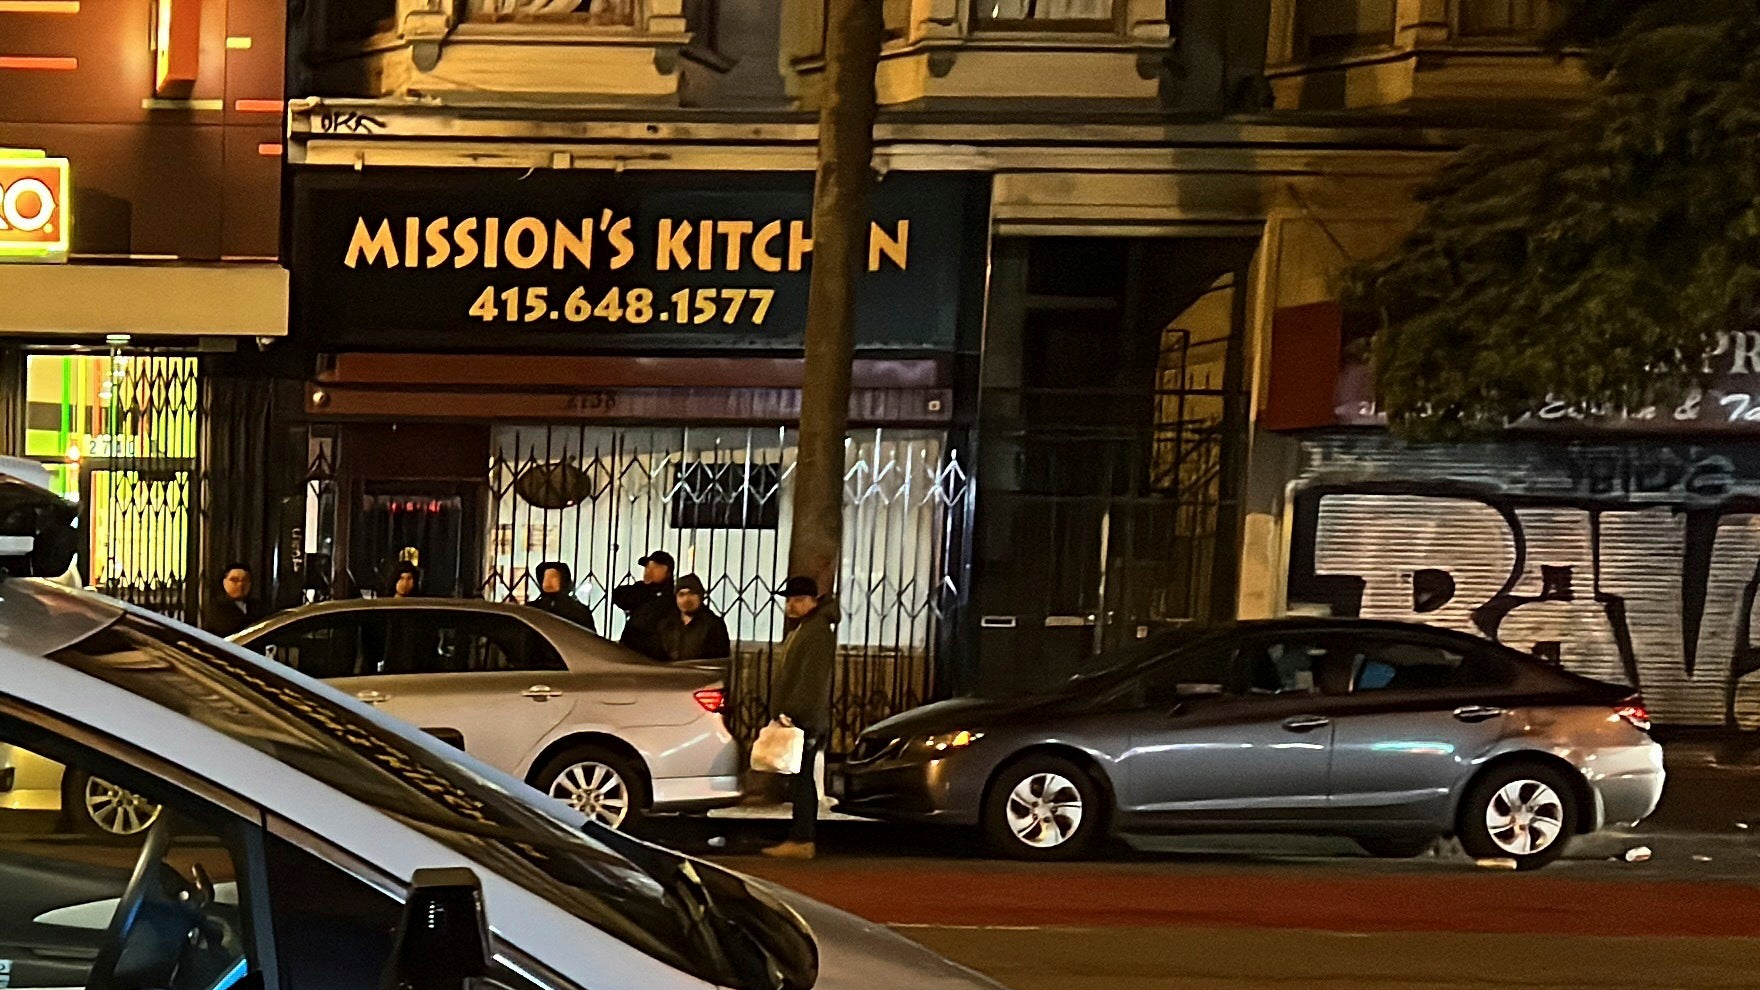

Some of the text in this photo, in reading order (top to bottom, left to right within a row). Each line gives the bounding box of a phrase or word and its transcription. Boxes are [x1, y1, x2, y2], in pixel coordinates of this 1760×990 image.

[343, 208, 911, 272] MISSION'S KITCHN
[468, 285, 776, 326] 415.648.1577
